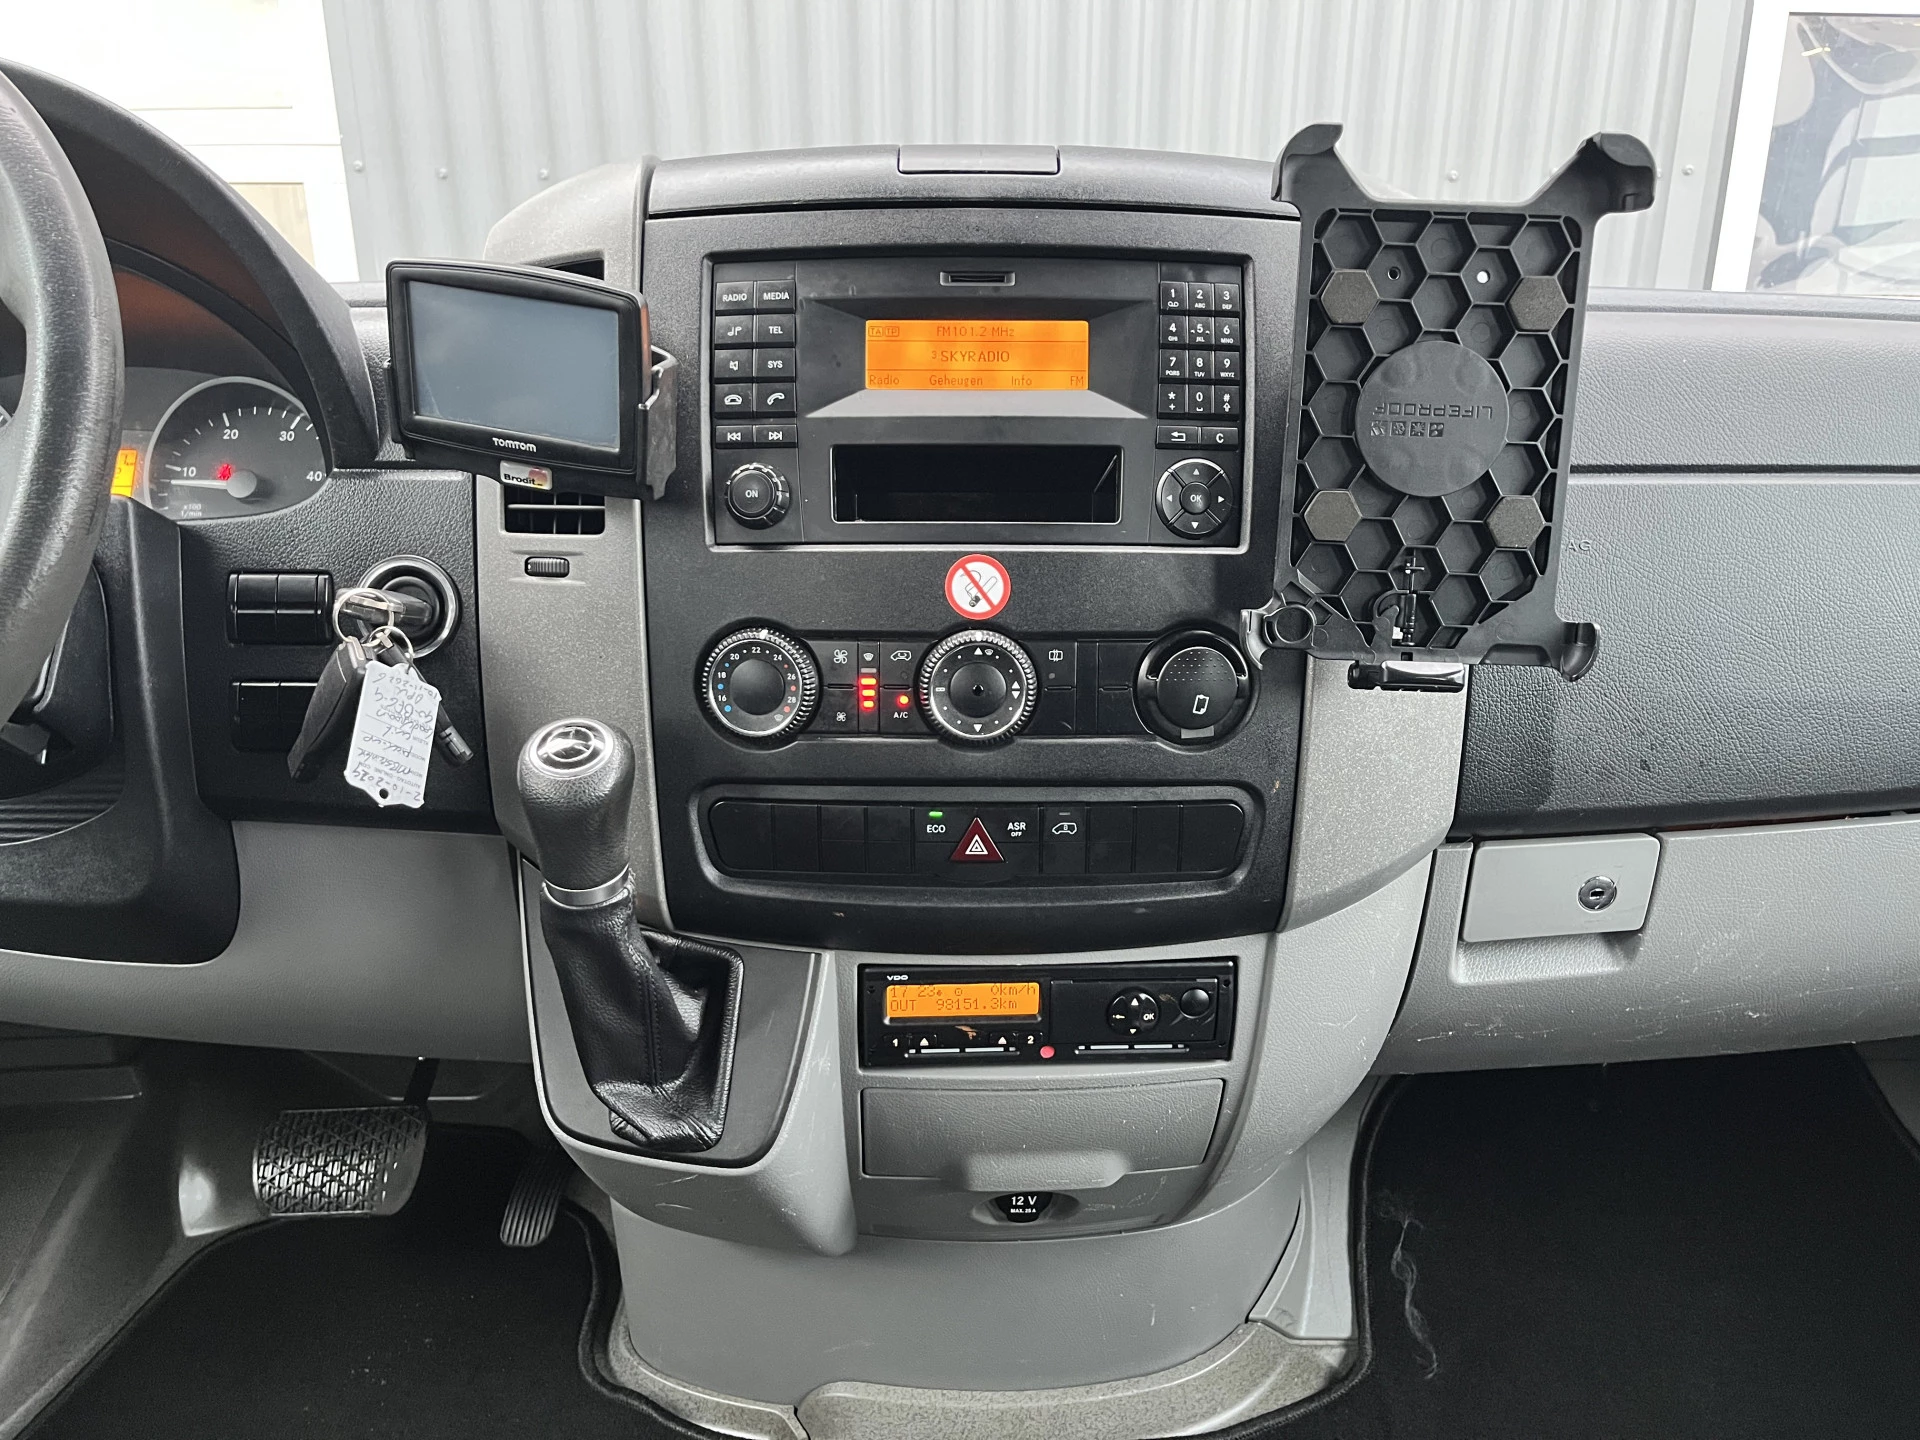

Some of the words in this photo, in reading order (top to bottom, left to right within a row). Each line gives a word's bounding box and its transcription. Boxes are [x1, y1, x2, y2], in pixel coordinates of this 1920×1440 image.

[722, 292, 748, 302] RADIO
[763, 291, 790, 300] MEDIA
[1170, 288, 1176, 298] 1
[1196, 289, 1204, 300] 2
[1223, 291, 1230, 301] 3
[768, 325, 784, 335] TEL
[936, 326, 987, 337] FM101.2
[991, 326, 1015, 337] MHz
[1169, 322, 1177, 333] 4
[1196, 323, 1204, 334] 5
[1223, 325, 1231, 335] 6
[940, 350, 1010, 362] SKYRADIO
[767, 360, 784, 369] SYS
[1169, 356, 1177, 367] 7
[1196, 357, 1204, 368] 8
[1223, 358, 1231, 369] 9
[869, 374, 900, 386] Radio
[929, 374, 983, 387] Geheugen
[1011, 374, 1033, 386] Info
[1069, 375, 1084, 386] FM
[1195, 392, 1204, 402] 0
[1372, 402, 1493, 420] LIFEPROOF
[222, 429, 239, 440] 20
[279, 431, 295, 442] 30
[1216, 433, 1224, 443] C
[492, 437, 537, 452] TOMTOM
[182, 467, 197, 478] 10
[306, 471, 323, 482] 40
[503, 473, 536, 485] Brodit
[745, 490, 759, 498] ON
[1190, 494, 1202, 503] OK
[717, 671, 727, 679] 18
[787, 673, 796, 681] 26
[718, 694, 727, 702] 16
[787, 696, 797, 704] 28
[893, 711, 909, 719] A/C
[927, 824, 946, 833] ECO
[1007, 822, 1026, 831] ASR
[991, 984, 1036, 996] 0km/h
[890, 1001, 916, 1011] OUT
[936, 999, 1017, 1010] 98151.3km
[1143, 1013, 1154, 1021] OK
[893, 1039, 898, 1047] 1
[1027, 1036, 1034, 1044] 2
[1011, 1196, 1024, 1205] 12
[1028, 1196, 1037, 1205] V
